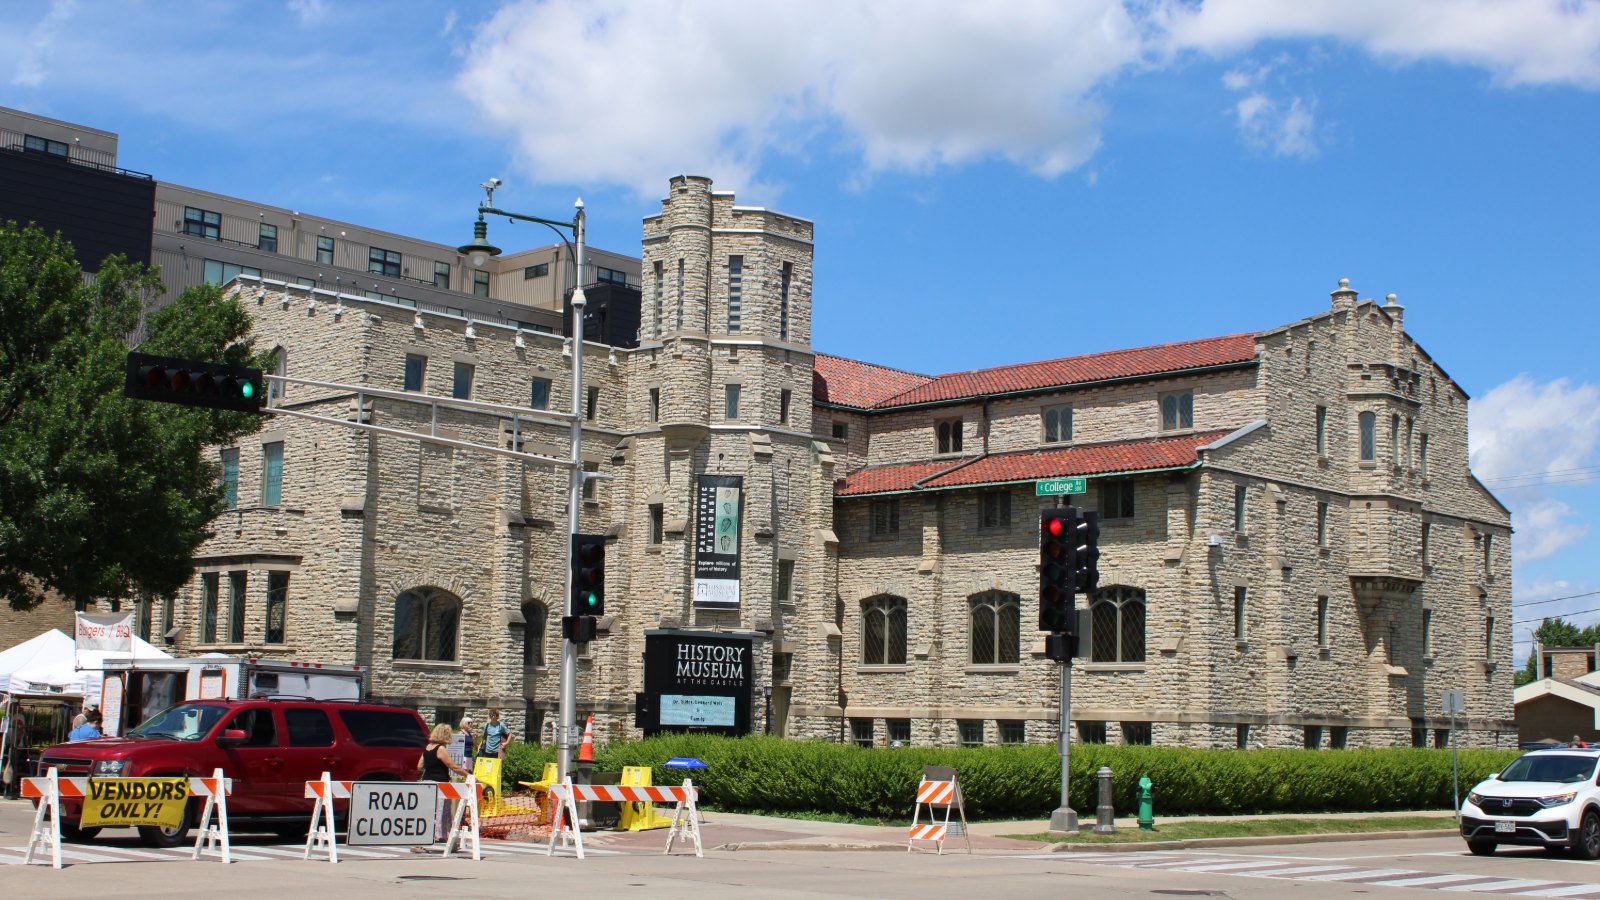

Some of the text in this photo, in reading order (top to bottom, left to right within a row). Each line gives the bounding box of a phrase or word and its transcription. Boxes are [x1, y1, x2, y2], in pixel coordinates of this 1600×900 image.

[1044, 481, 1074, 493] College
[698, 486, 708, 553] PREHISTORIC
[706, 487, 716, 553] WISCONSIN
[79, 623, 106, 639] Burgers
[115, 623, 131, 638] BBQ
[677, 643, 745, 663] HISTORY
[676, 660, 745, 679] MUSEUM
[89, 781, 186, 800] VENDORS
[100, 802, 163, 819] ONLY!
[368, 791, 419, 811] ROAD
[356, 817, 427, 837] CLOSED
